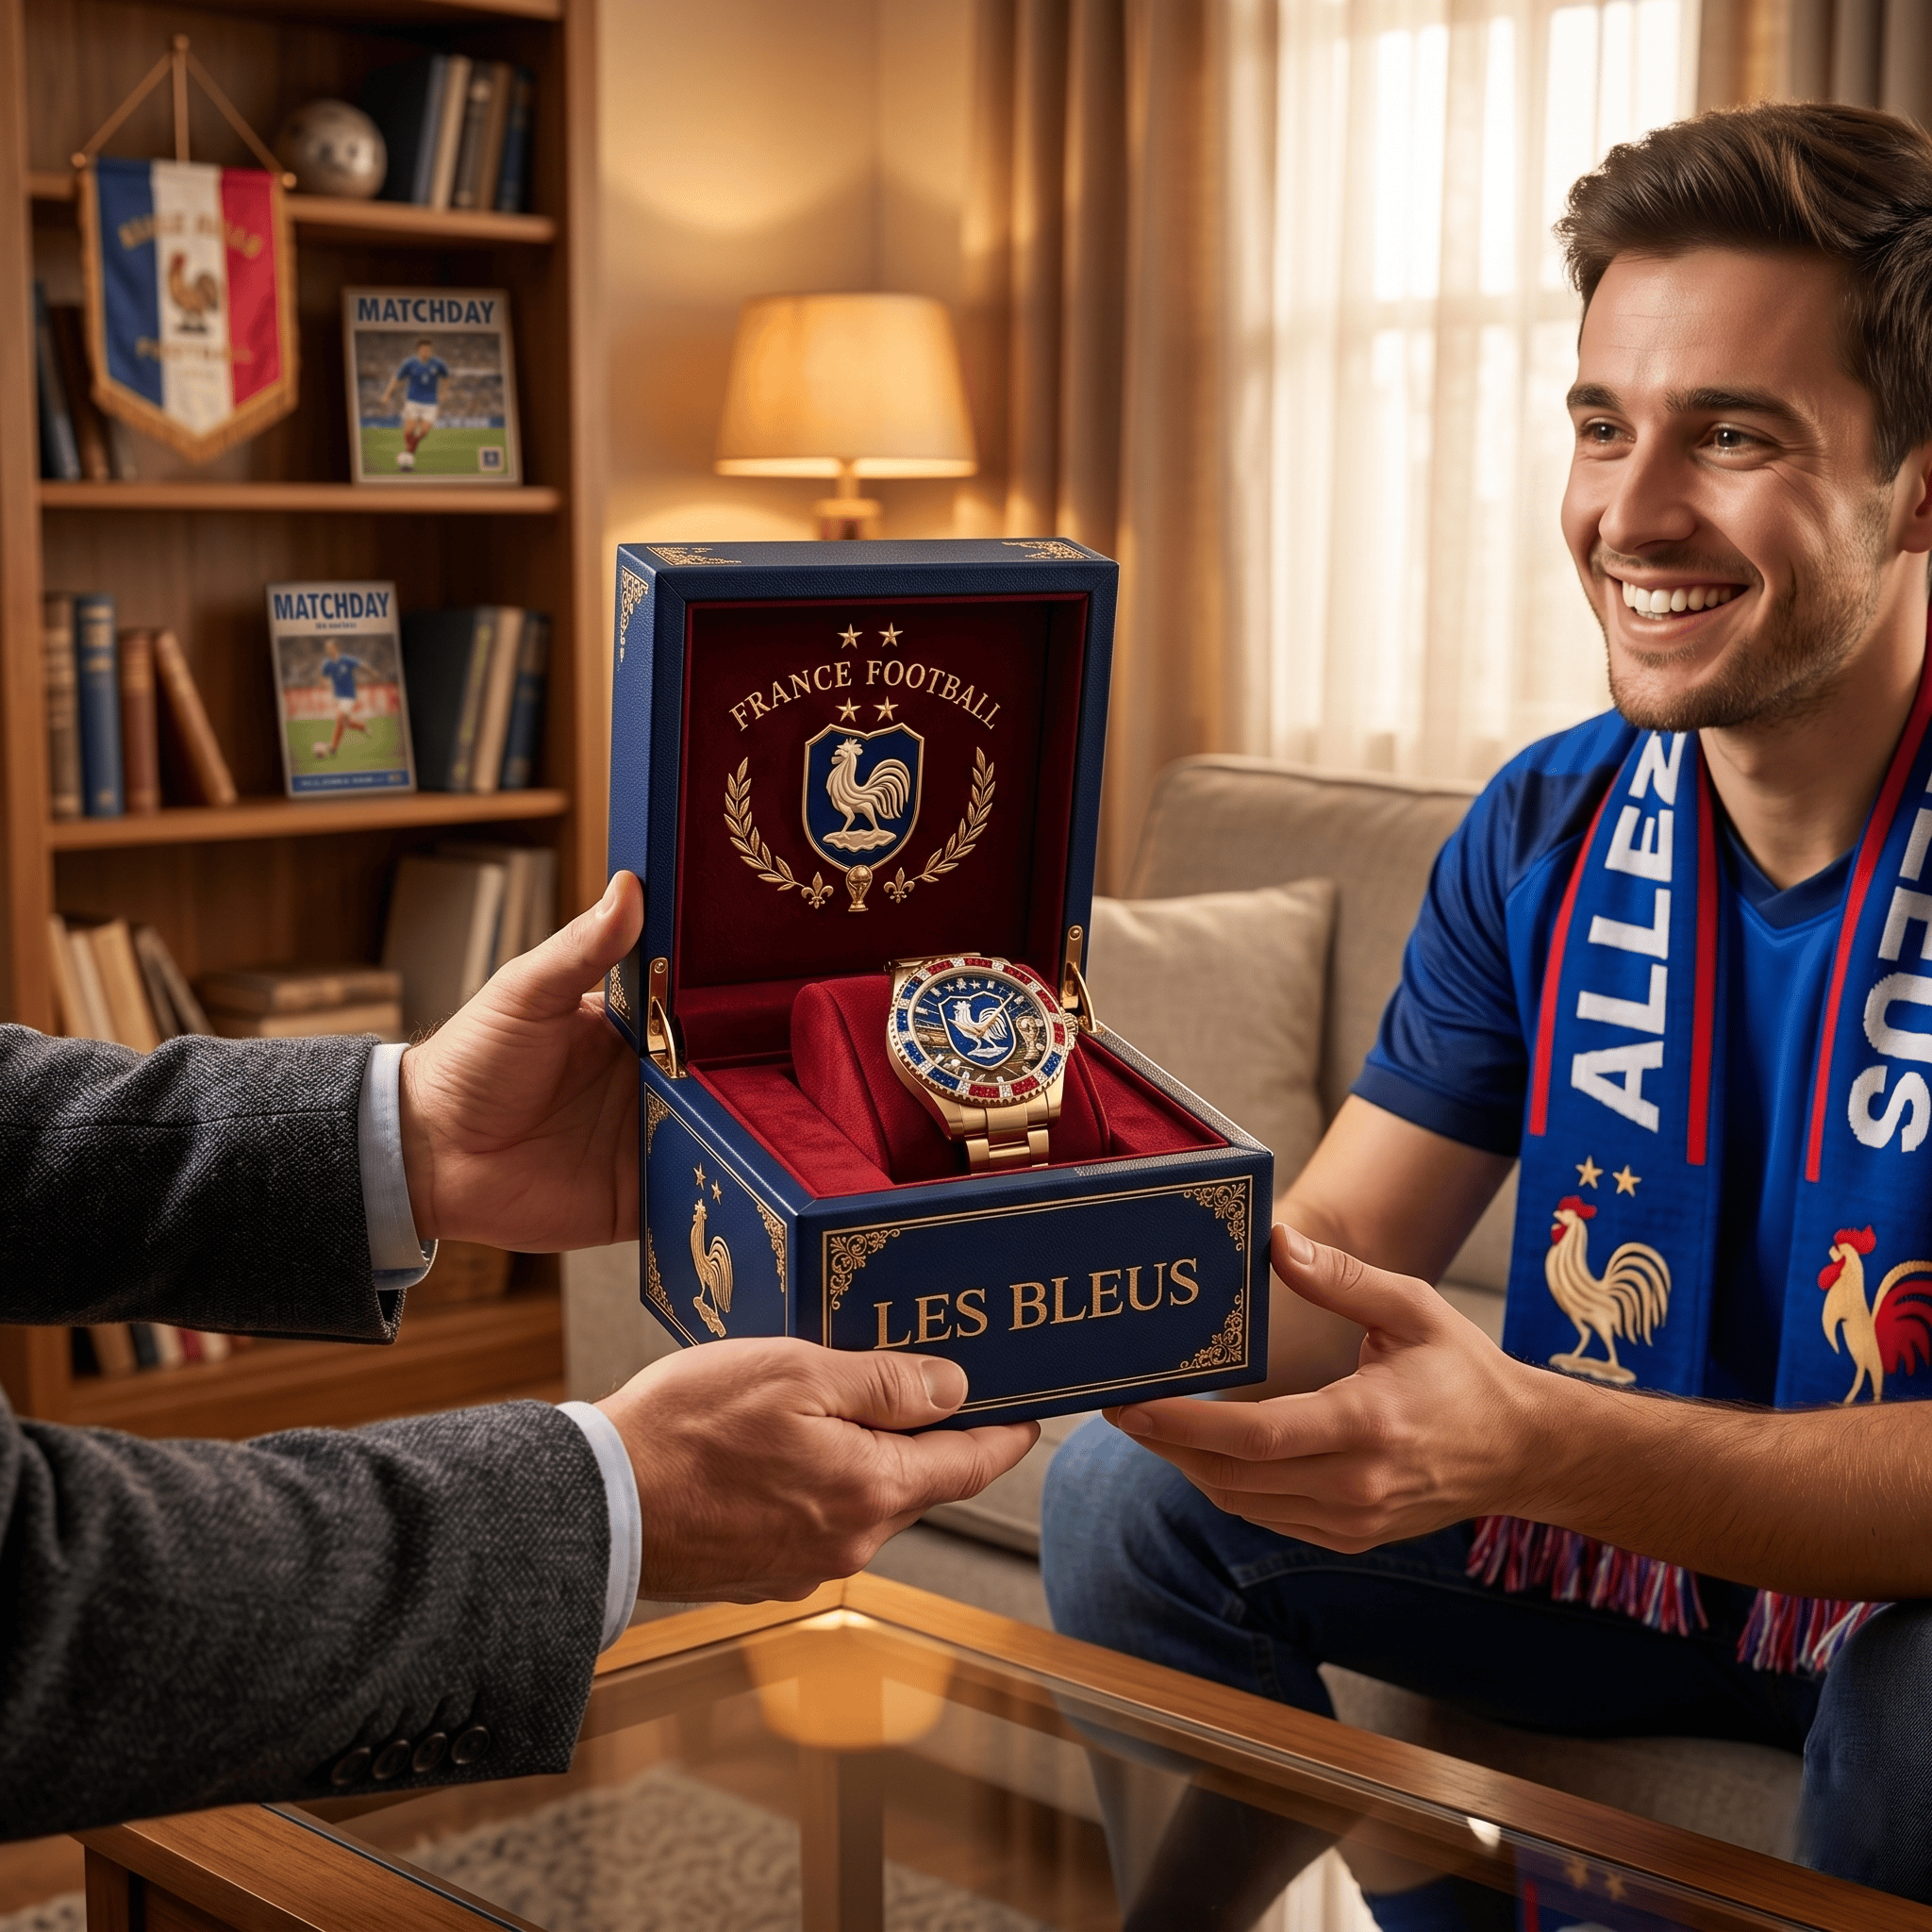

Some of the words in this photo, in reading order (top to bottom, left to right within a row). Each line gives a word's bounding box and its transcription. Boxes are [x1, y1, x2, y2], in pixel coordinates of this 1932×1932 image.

[358, 297, 495, 325] MATCHDAY
[273, 591, 391, 620] MATCHDAY
[728, 659, 852, 732] FRANCE
[865, 659, 1002, 730] FOOTBALL
[1571, 730, 1687, 1133] ALLEZ
[873, 1287, 989, 1351] LES
[1008, 1257, 1200, 1331] BLEUS
